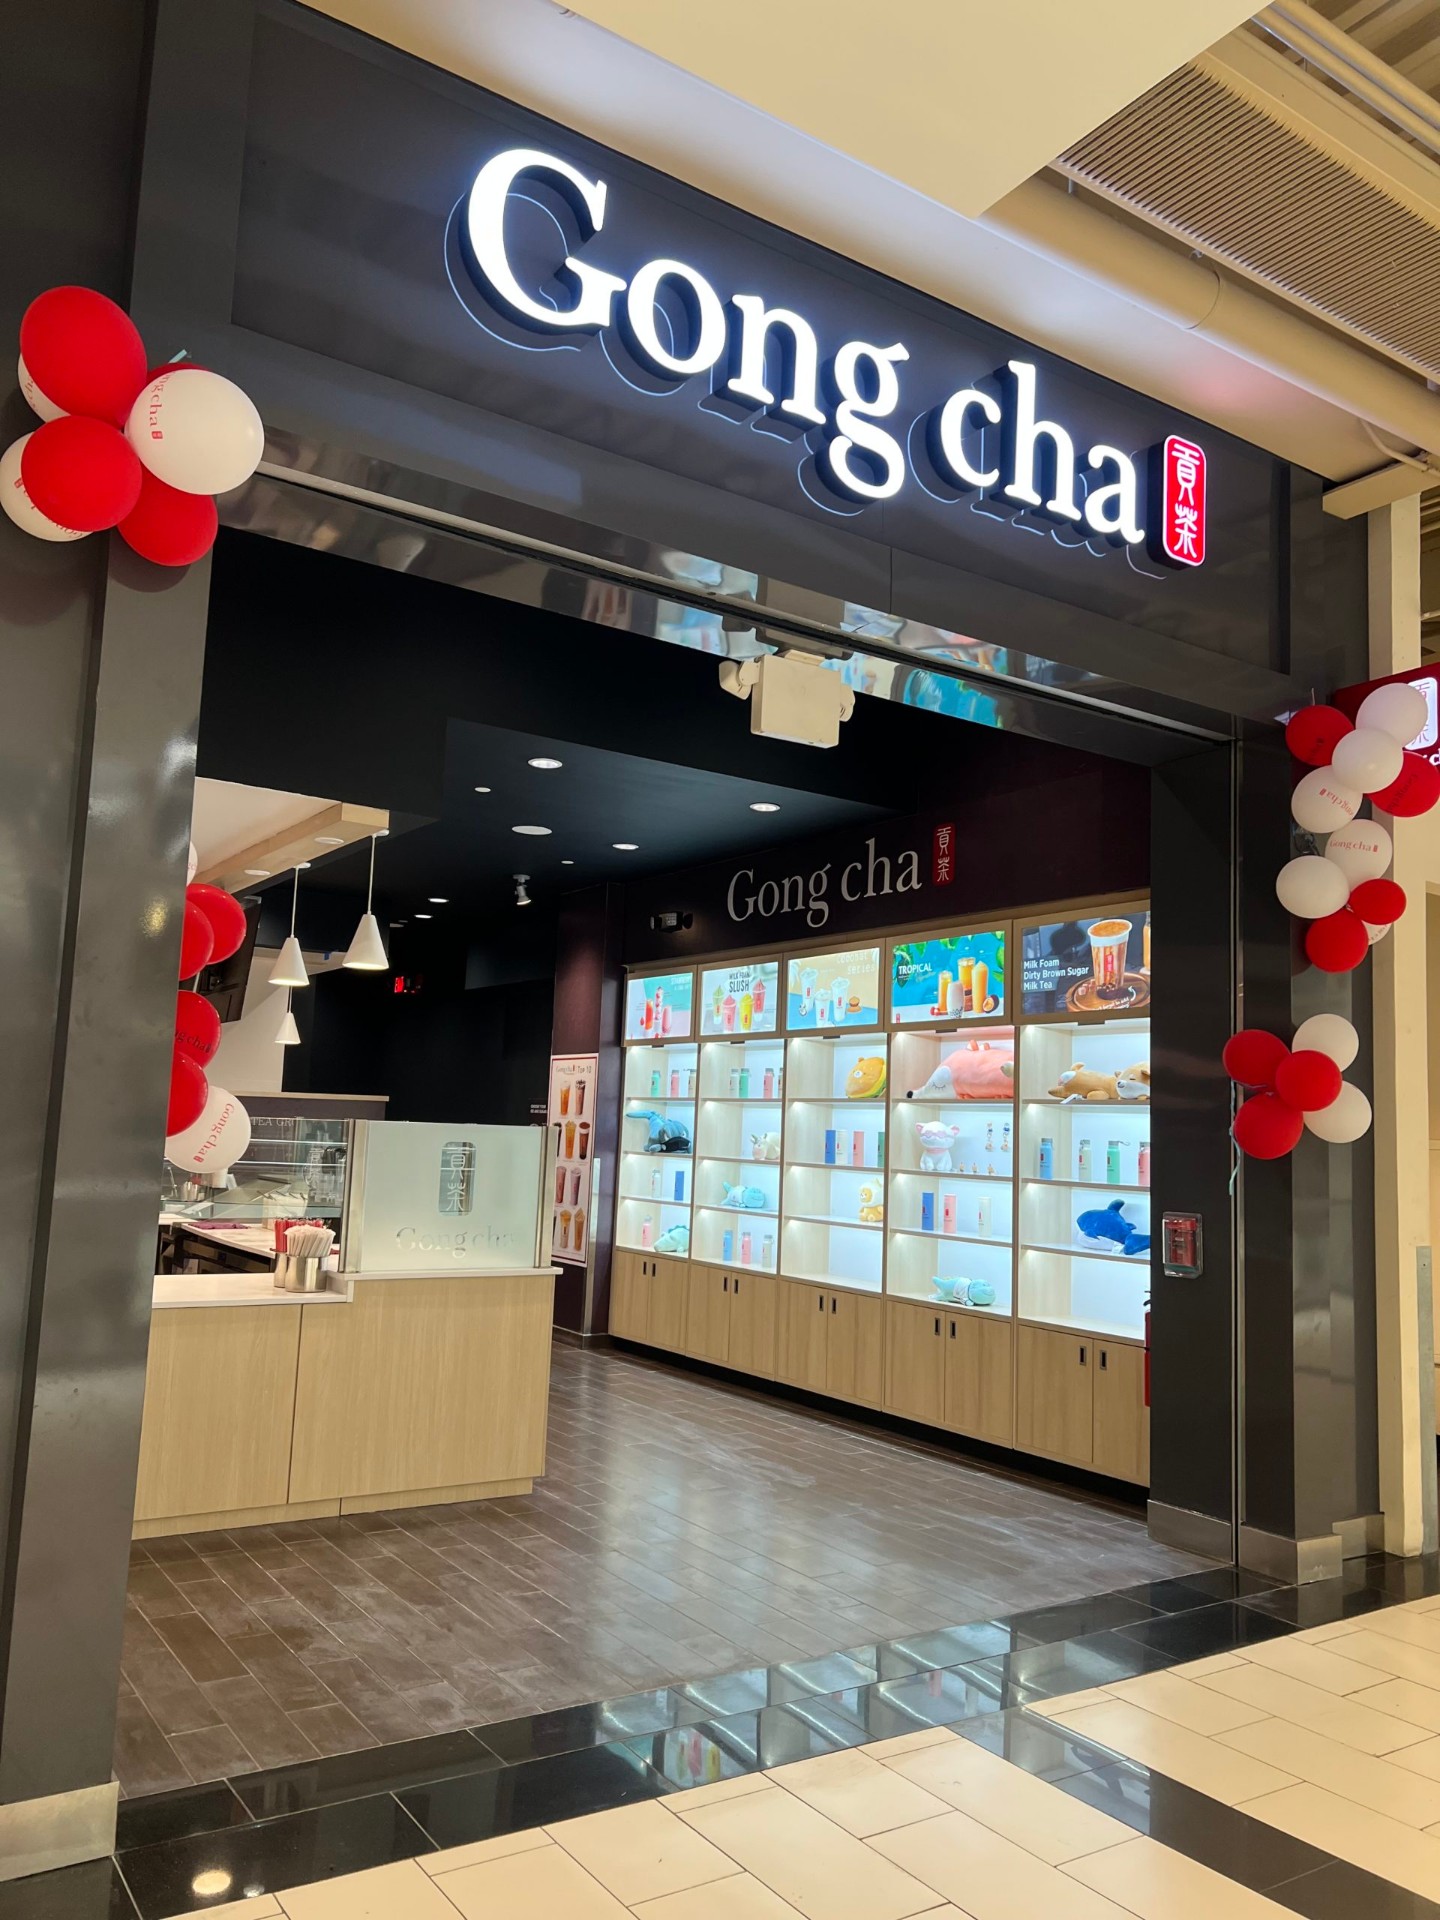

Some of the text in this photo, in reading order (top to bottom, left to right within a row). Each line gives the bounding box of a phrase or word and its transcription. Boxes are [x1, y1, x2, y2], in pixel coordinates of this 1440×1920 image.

[467, 148, 1145, 544] Gong cha
[1171, 442, 1201, 559] 貢茶
[937, 826, 952, 882] 貢茶
[727, 837, 922, 927] Gong cha
[898, 962, 933, 975] TROPICAL
[1023, 959, 1059, 969] Milk Foam
[1023, 966, 1089, 981] Dirty Brown Sugar
[729, 979, 750, 993] SLUSH
[1023, 980, 1053, 991] Milk Tea
[199, 1103, 235, 1156] Gong cha
[252, 1117, 273, 1126] TEA
[396, 1226, 468, 1259] Gong
